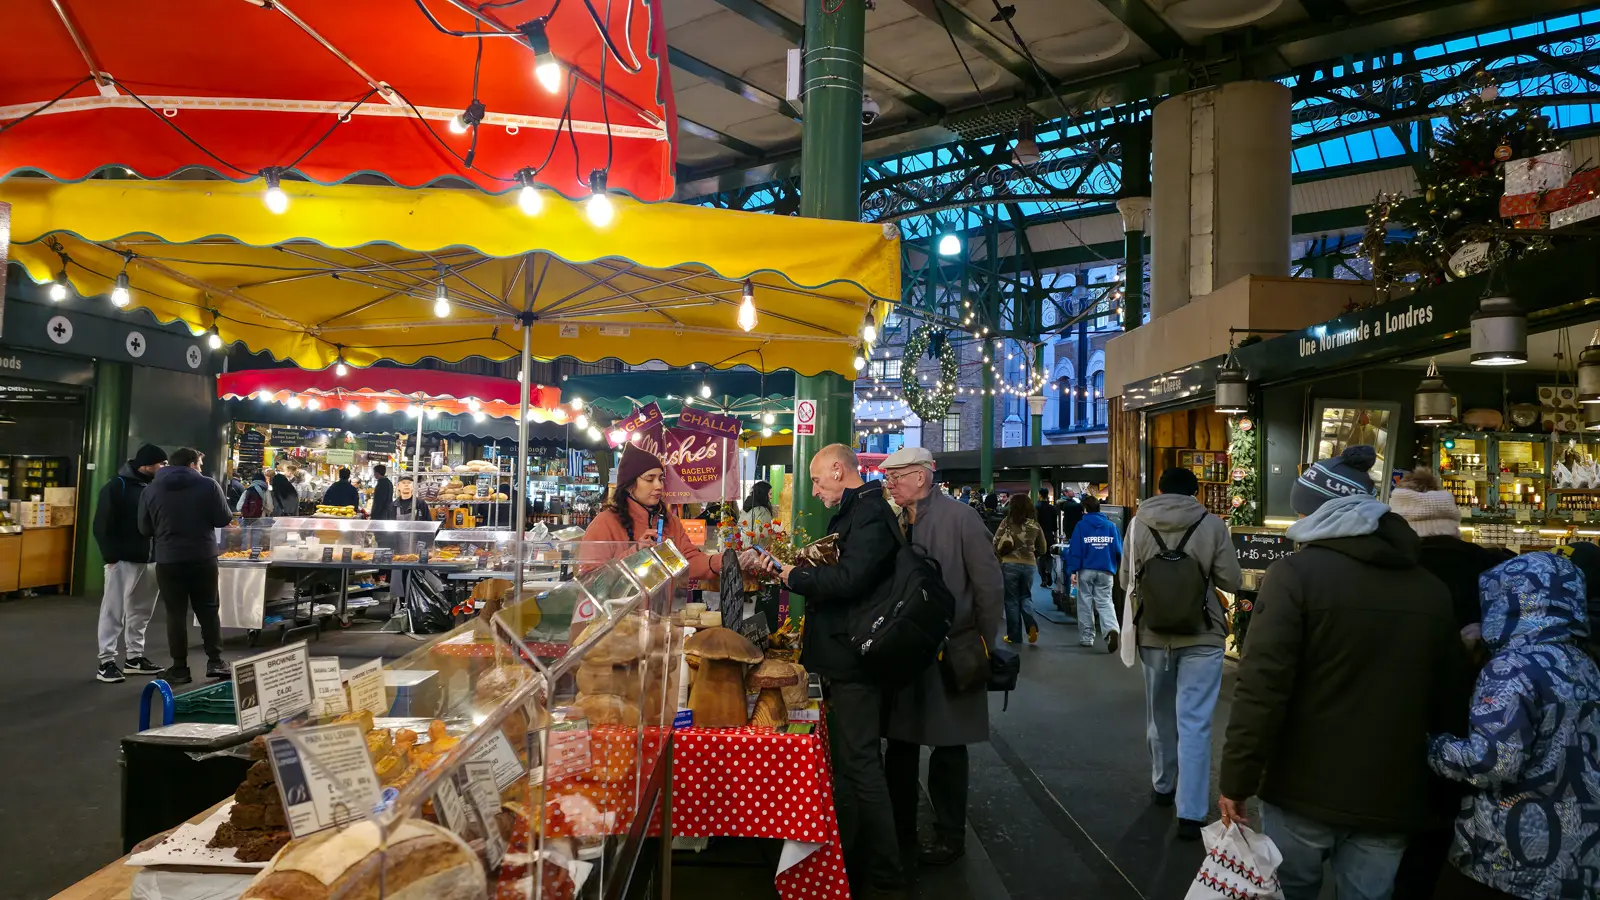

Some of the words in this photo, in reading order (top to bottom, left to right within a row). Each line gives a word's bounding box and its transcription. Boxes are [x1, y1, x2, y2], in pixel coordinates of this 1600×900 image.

[1299, 338, 1317, 358] Une
[1319, 320, 1370, 353] Normande
[1374, 323, 1381, 337] a
[1385, 304, 1434, 334] Londres
[681, 412, 738, 435] CHALLA
[641, 434, 718, 466] Mishe's
[681, 467, 717, 475] BAGELRY
[687, 474, 718, 483] BAKERY
[267, 653, 297, 668] BROWNIE
[276, 686, 292, 696] £4.00
